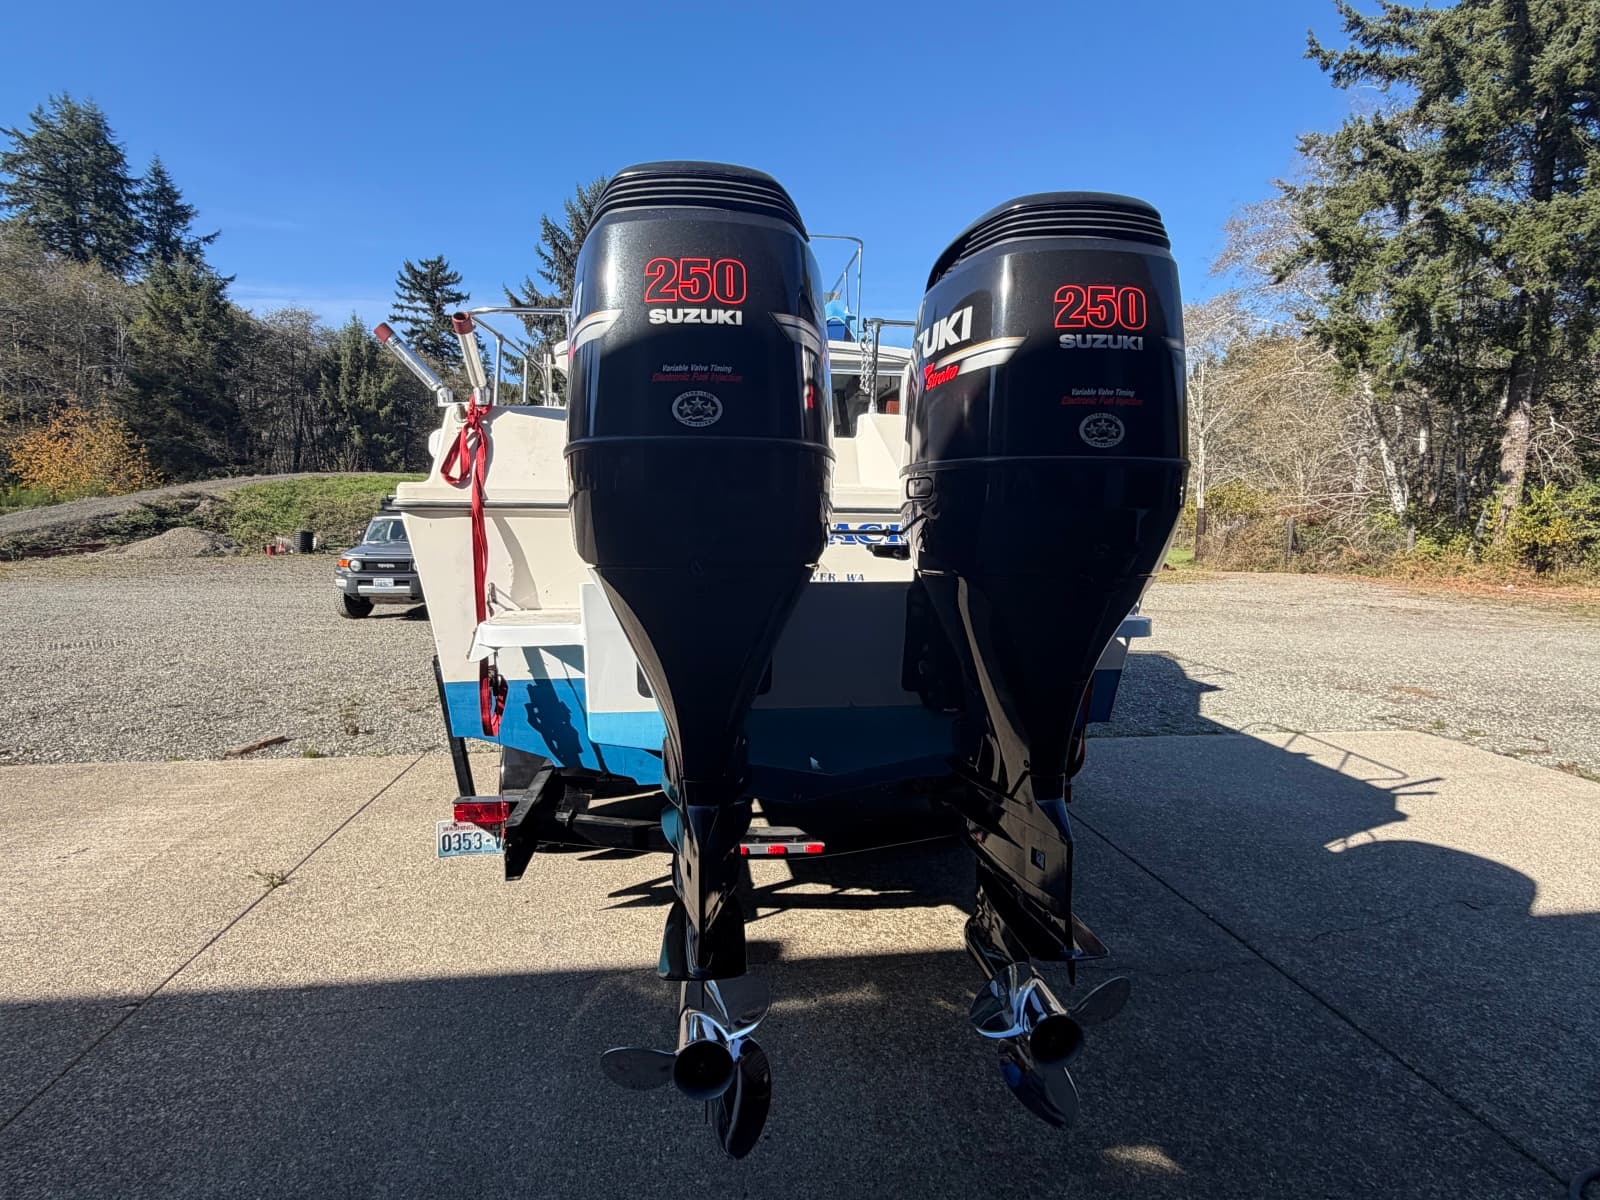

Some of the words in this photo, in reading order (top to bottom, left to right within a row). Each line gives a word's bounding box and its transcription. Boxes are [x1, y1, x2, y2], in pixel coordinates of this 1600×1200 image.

[644, 257, 747, 304] 250
[1053, 284, 1147, 330] 250
[649, 308, 743, 325] SUZUKI
[917, 305, 973, 358] UKI
[1059, 334, 1143, 351] SUZUKI
[662, 363, 689, 372] Variable
[690, 363, 708, 372] Valve
[710, 363, 732, 374] Timing
[1071, 387, 1097, 396] Variable
[1098, 387, 1114, 396] Valve
[1116, 387, 1136, 398] Timing
[847, 573, 864, 582] WA
[441, 831, 504, 853] 0353-V
